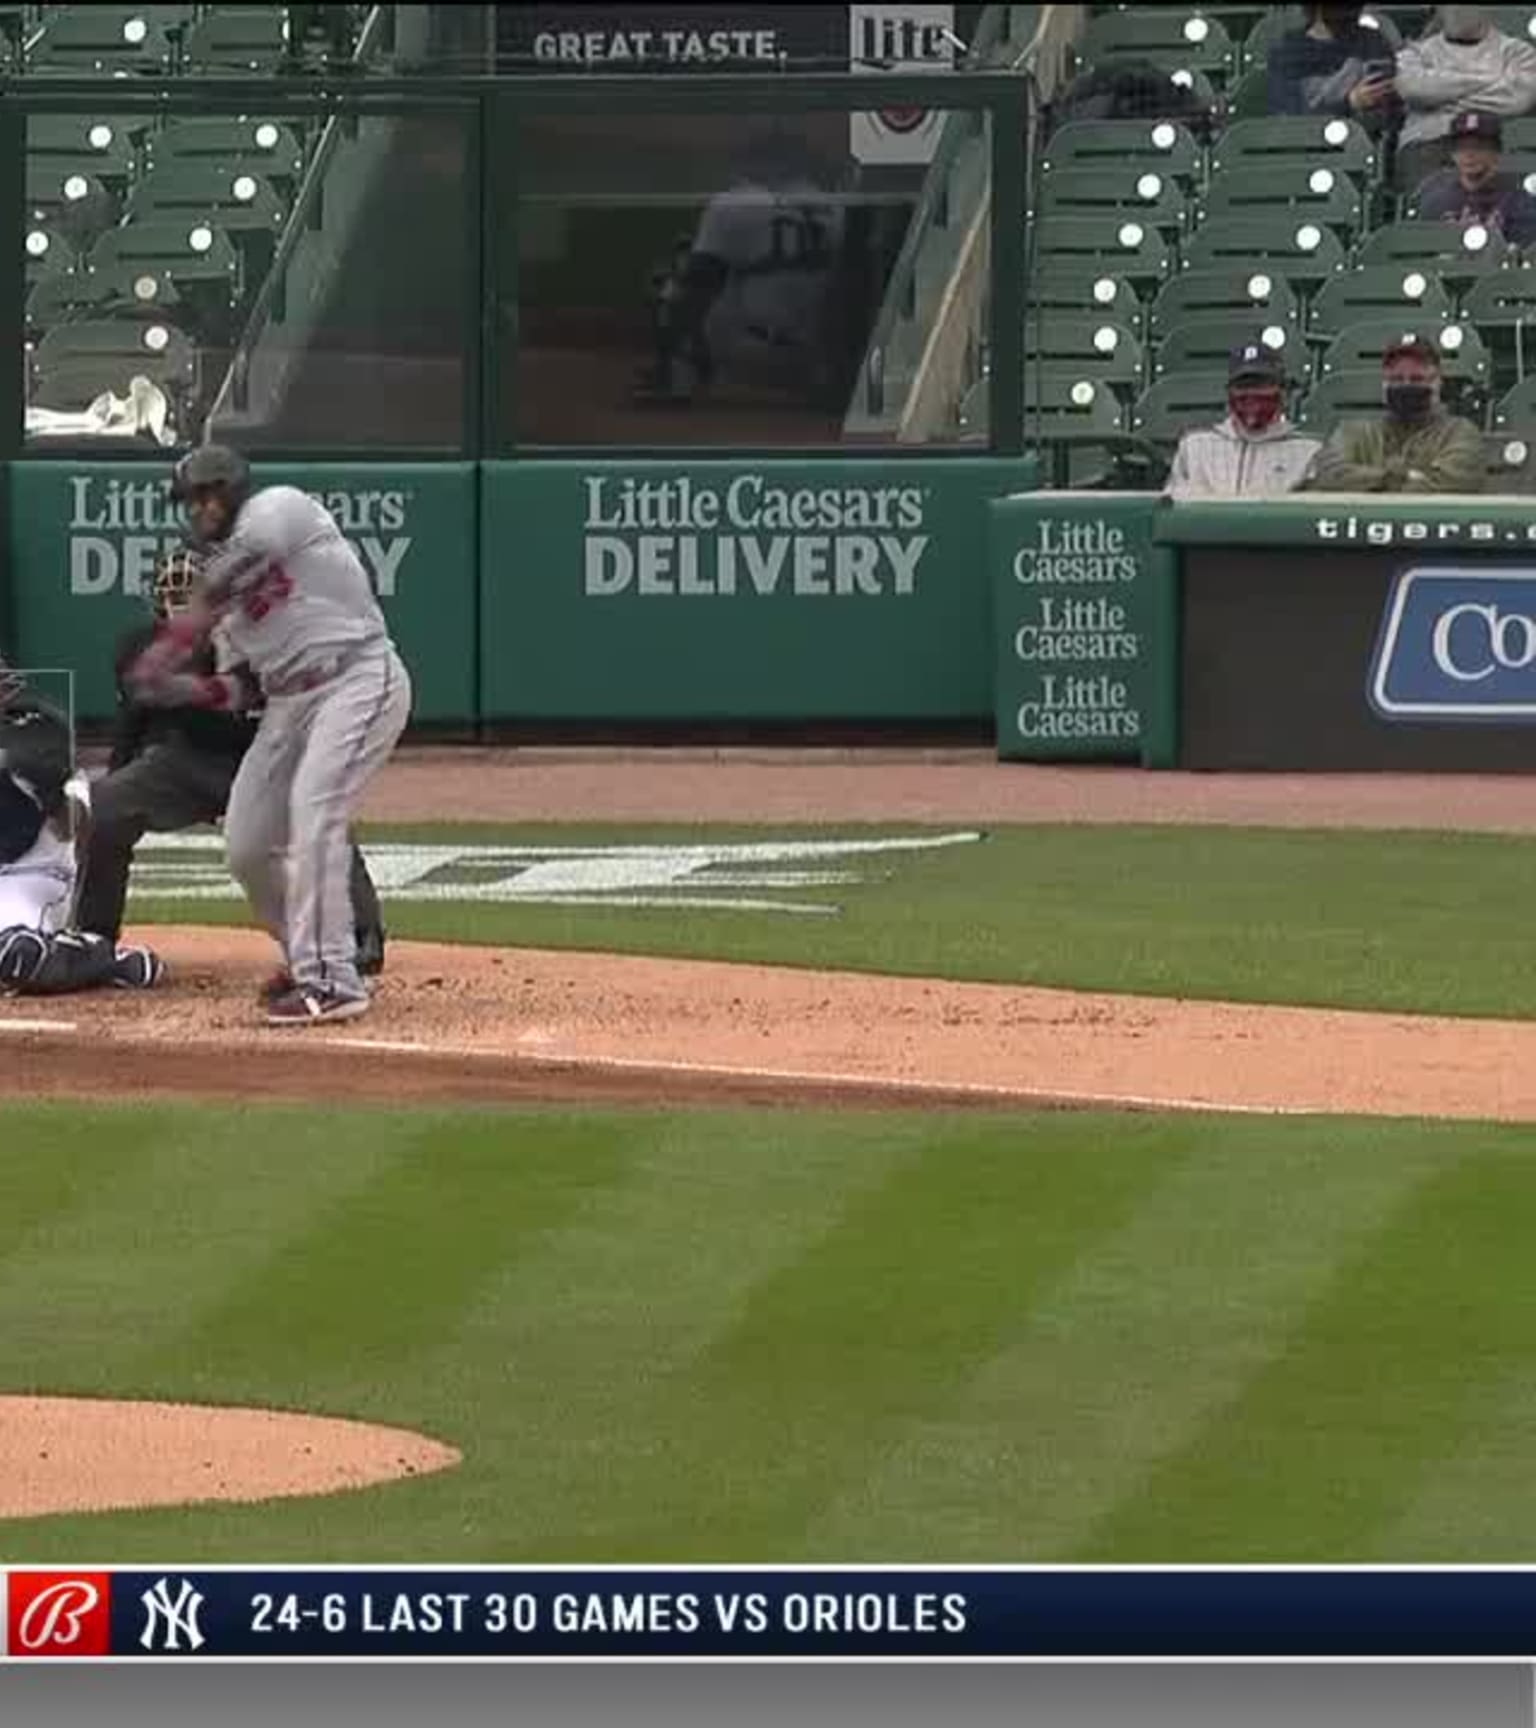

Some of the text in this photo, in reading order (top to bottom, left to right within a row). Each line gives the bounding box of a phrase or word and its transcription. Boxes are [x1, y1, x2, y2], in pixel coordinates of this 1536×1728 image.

[534, 31, 788, 61] GREAT TASTE.
[583, 475, 923, 529] Little Caesars
[1038, 519, 1124, 555] Little
[585, 535, 928, 595] DELIVERY
[1014, 549, 1136, 583] Caesars
[1040, 597, 1125, 632] Little
[1015, 626, 1137, 660] Caesars
[1043, 675, 1127, 710] Little
[1017, 702, 1140, 737] Caesars
